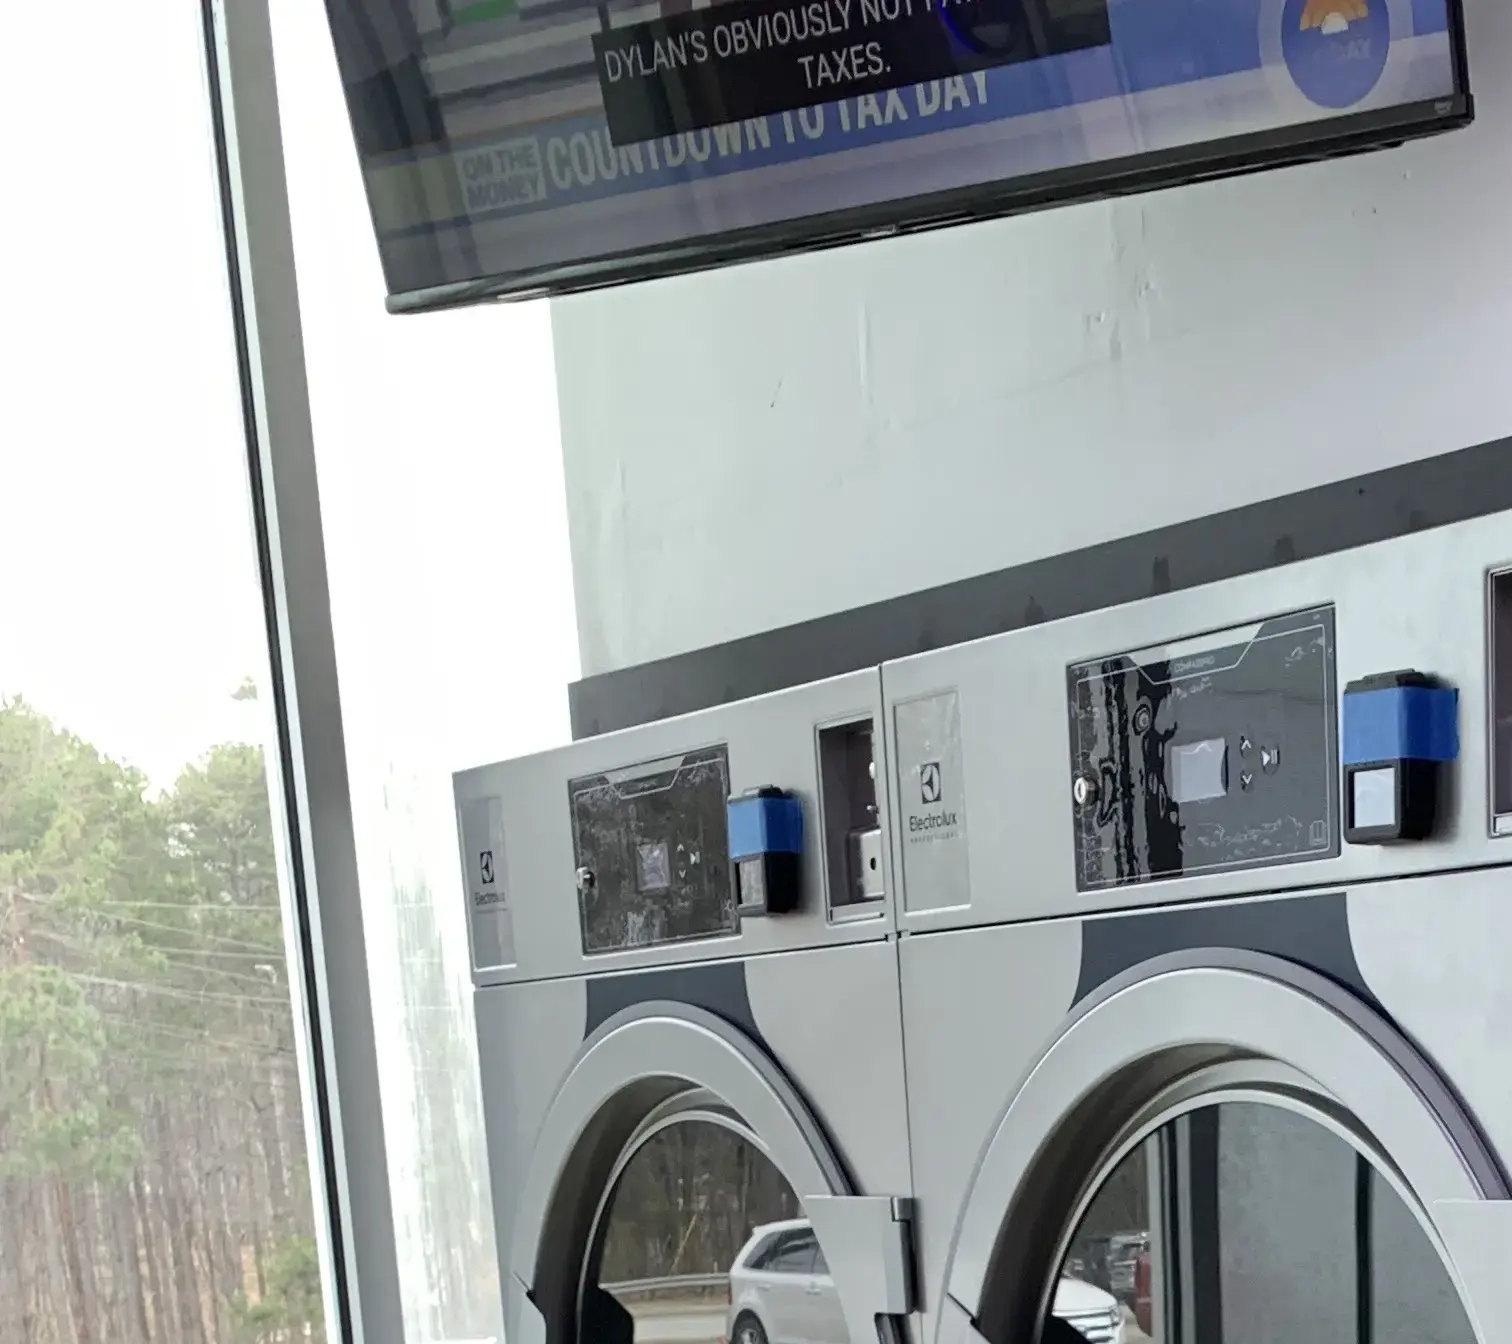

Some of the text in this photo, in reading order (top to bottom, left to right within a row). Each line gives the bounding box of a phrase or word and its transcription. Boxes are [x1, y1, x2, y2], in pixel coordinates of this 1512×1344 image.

[604, 31, 708, 83] DYLAN'S
[714, 0, 852, 57] OBVIOUSLY
[797, 42, 891, 89] TAXES.
